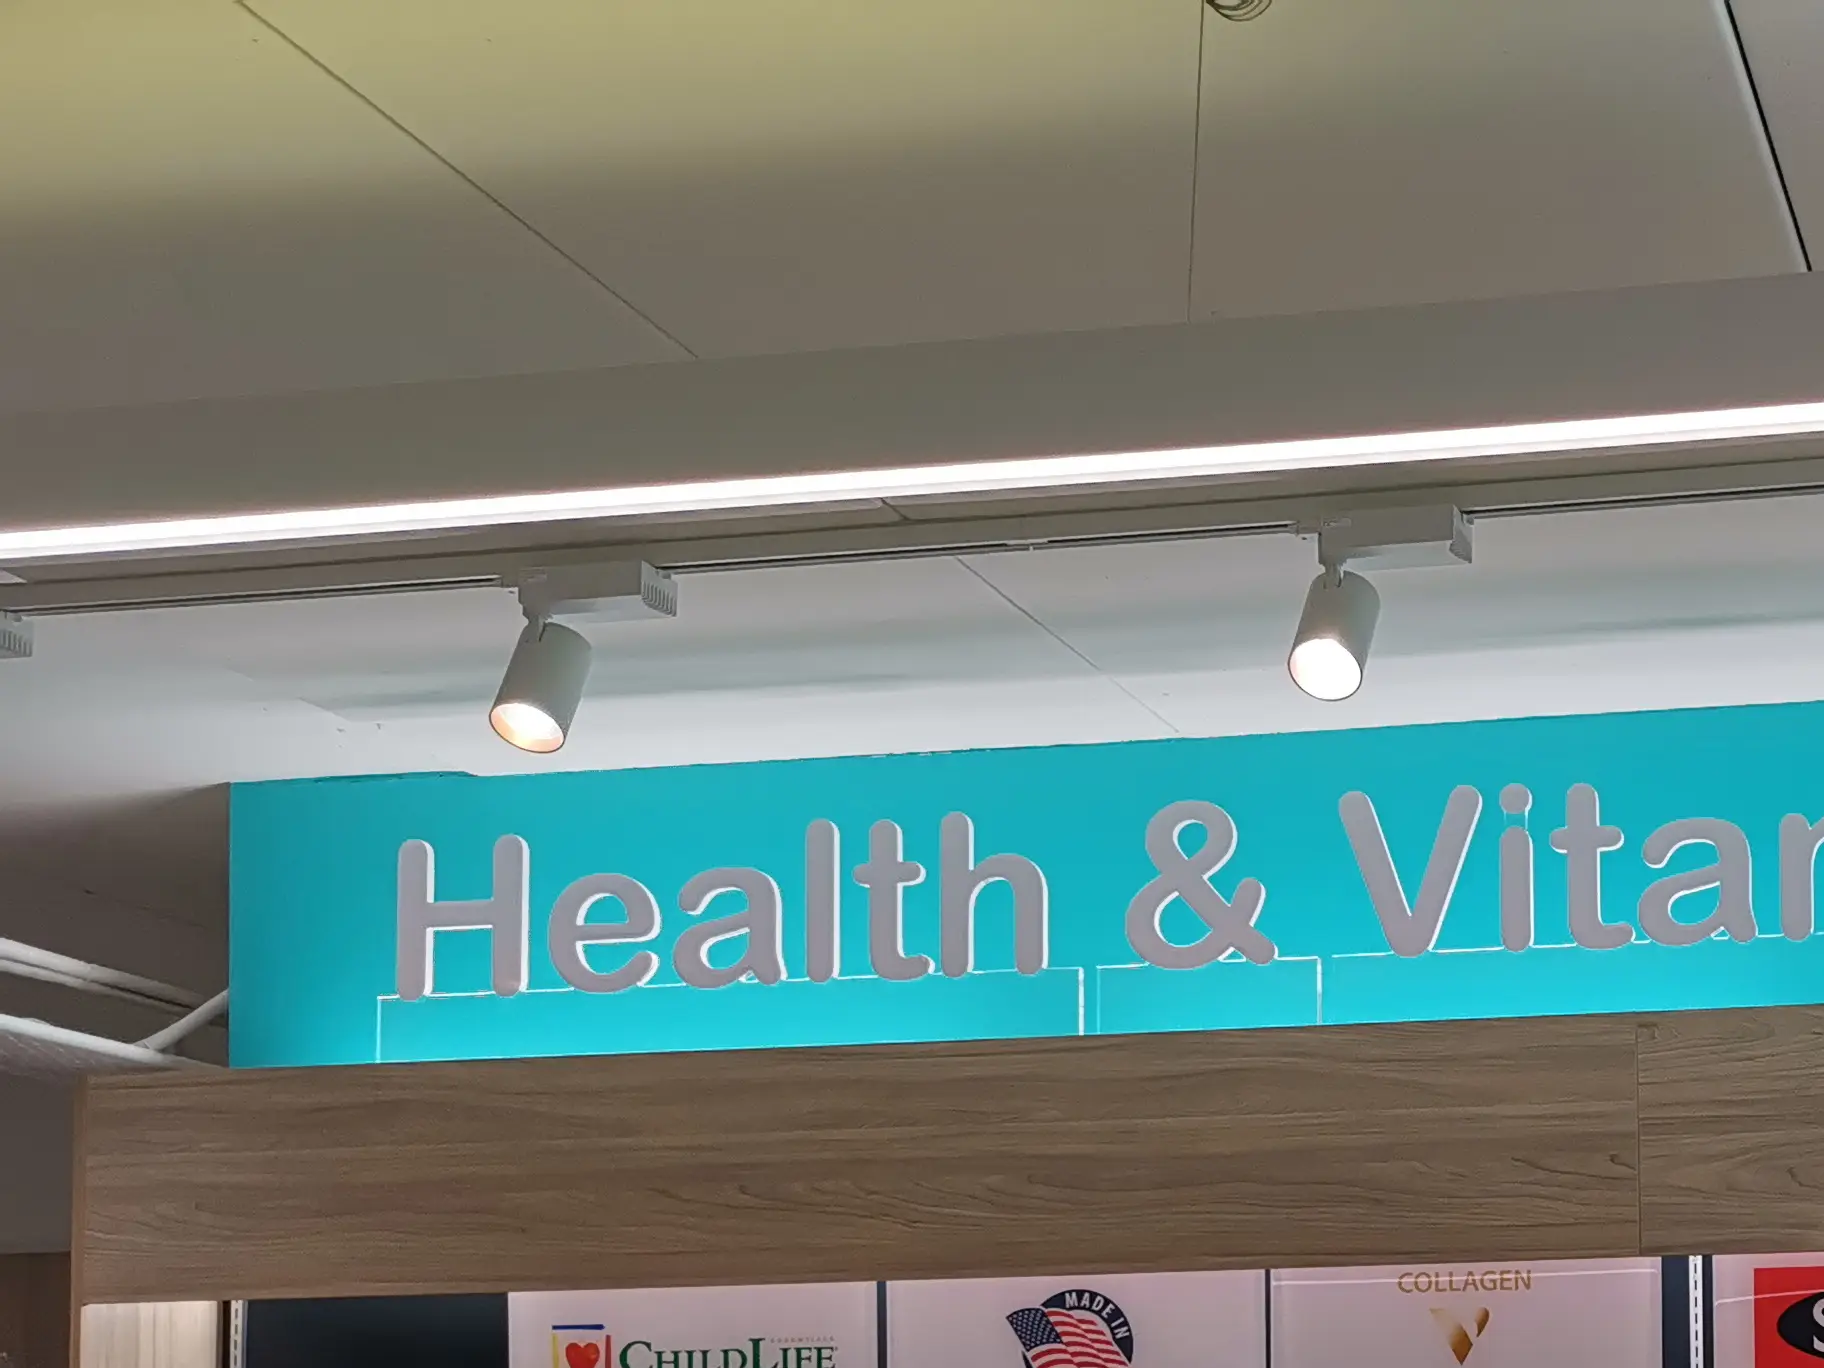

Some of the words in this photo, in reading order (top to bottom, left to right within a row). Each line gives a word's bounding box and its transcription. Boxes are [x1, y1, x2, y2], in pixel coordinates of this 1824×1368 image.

[398, 811, 1050, 1001] Health
[1125, 799, 1272, 968] &
[1397, 1269, 1531, 1293] COLLAGEN
[1065, 1292, 1116, 1319] MADE
[1111, 1317, 1130, 1339] IN
